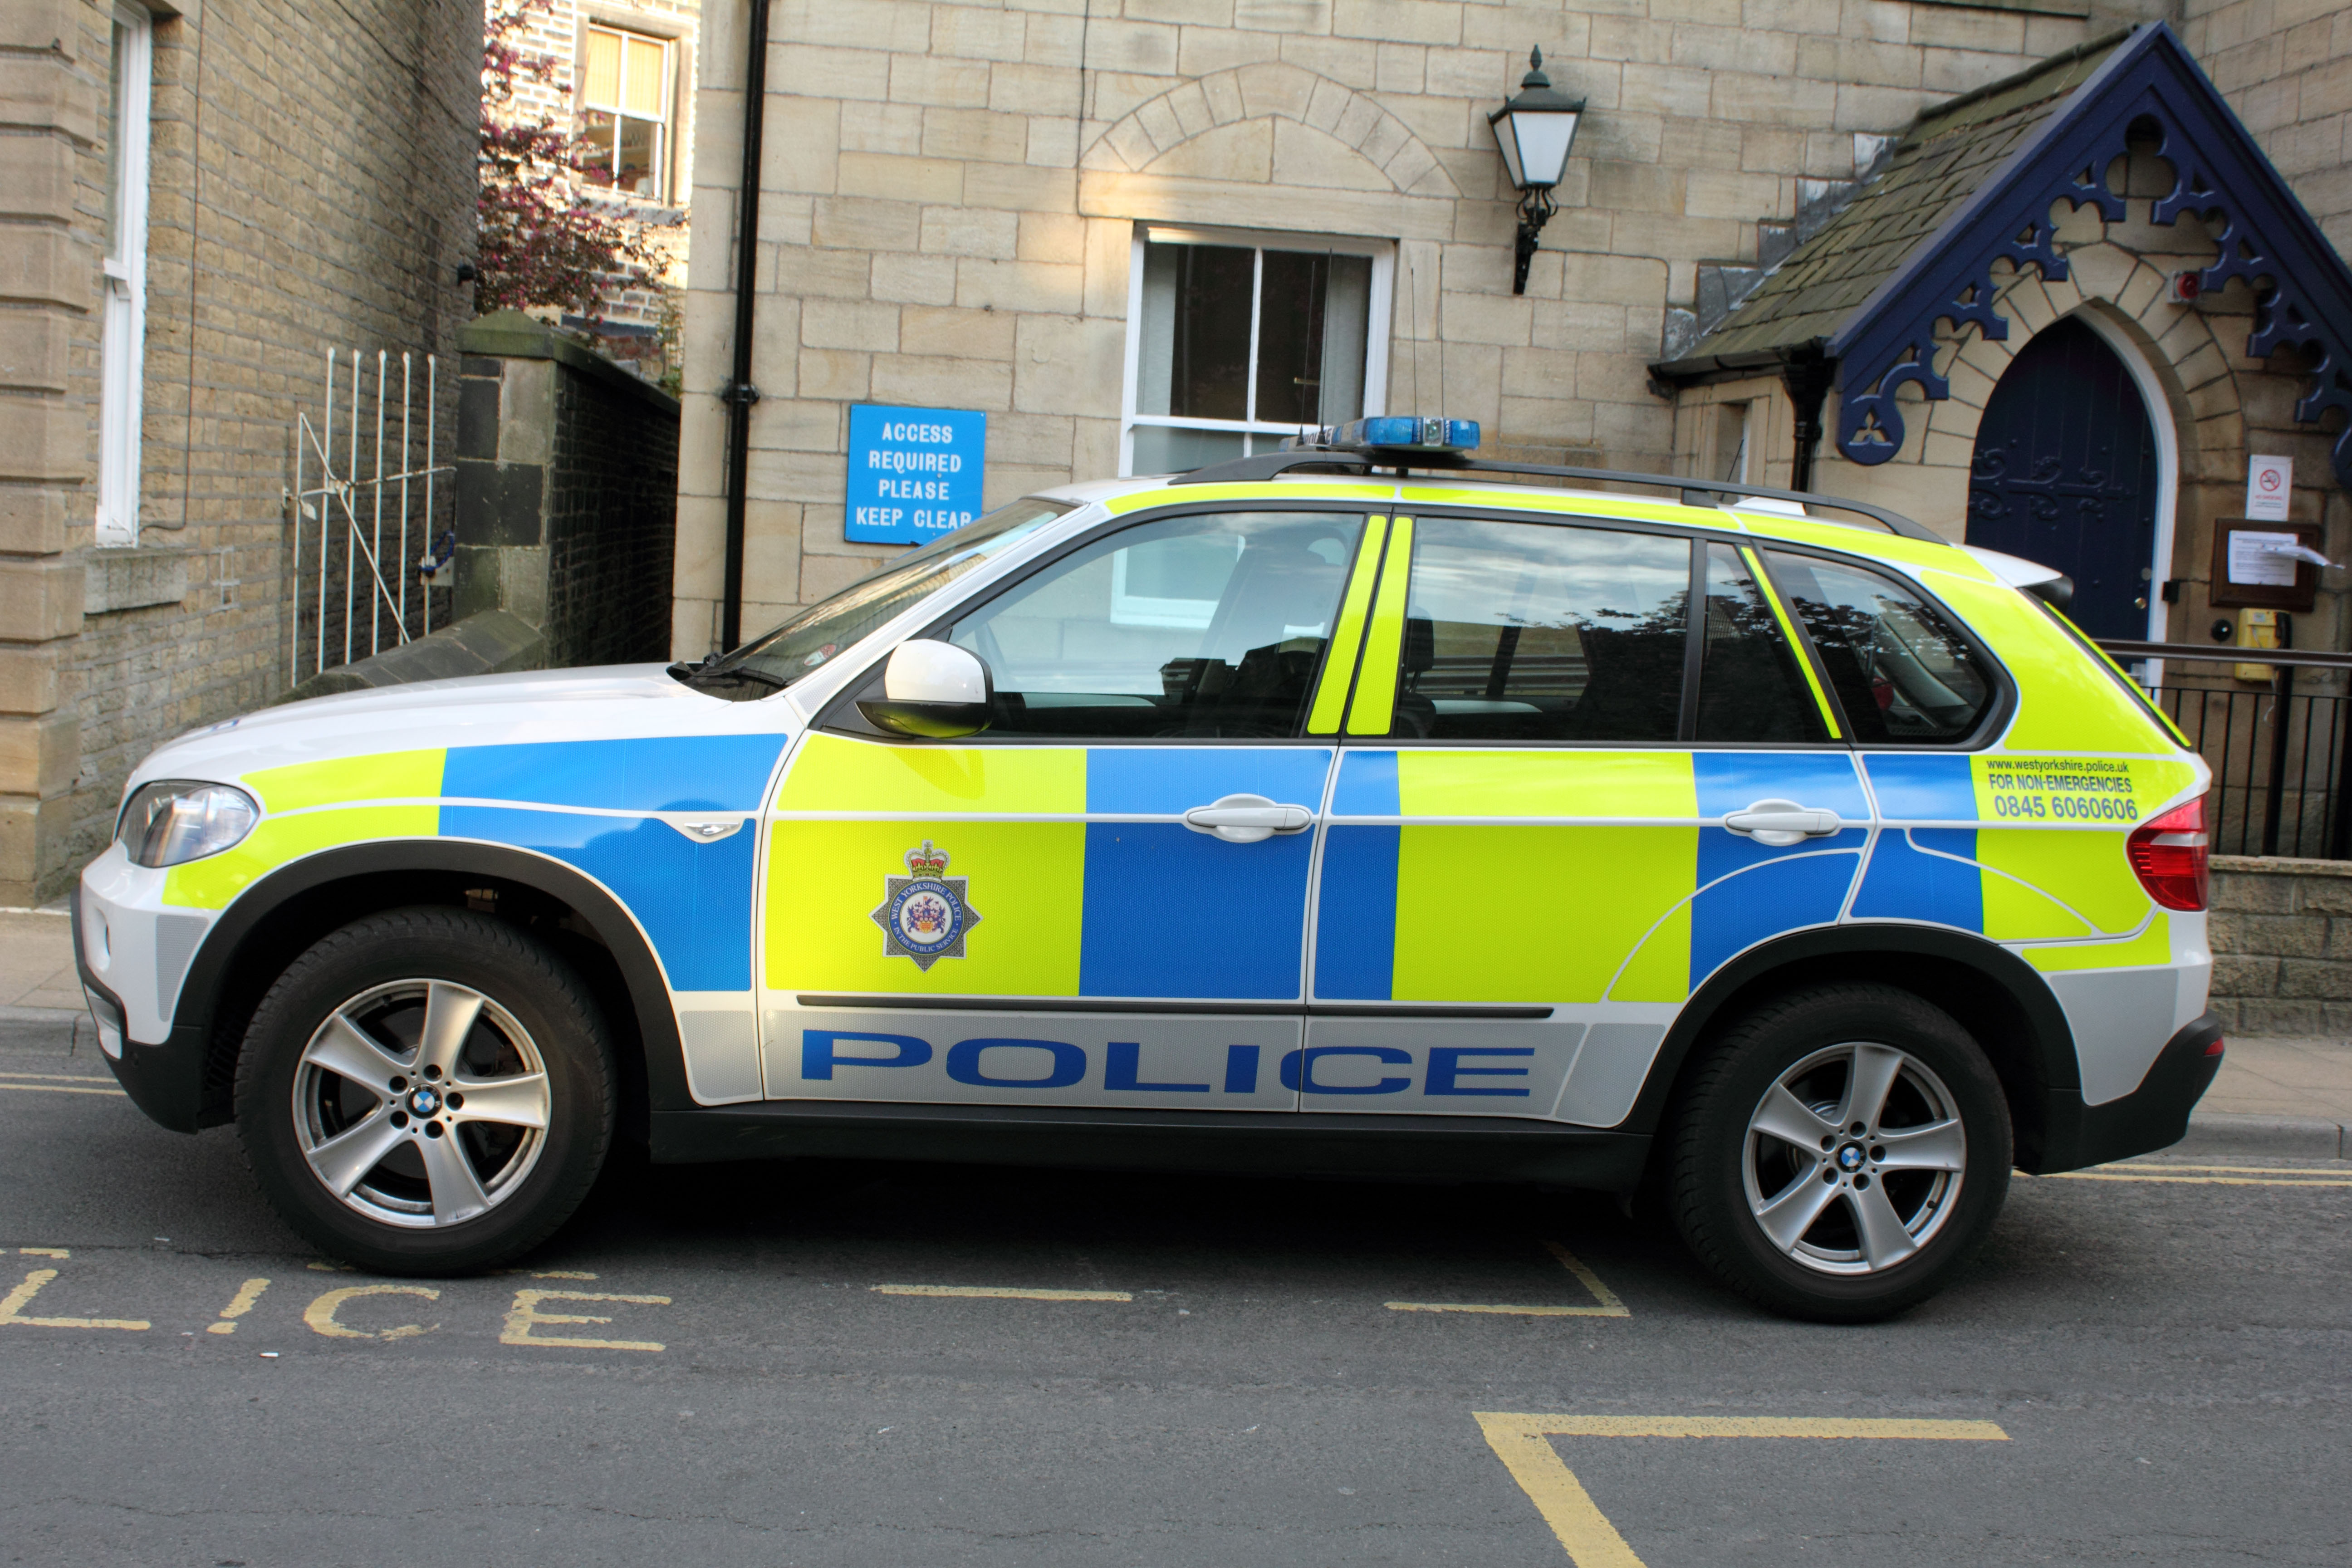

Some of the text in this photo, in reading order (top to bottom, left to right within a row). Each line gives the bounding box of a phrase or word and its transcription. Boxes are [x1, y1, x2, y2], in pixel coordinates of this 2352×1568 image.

[882, 422, 953, 443] ACCESS
[868, 450, 962, 474] REQUIRED
[879, 479, 950, 500] PLEASE
[856, 506, 971, 529] KEEP CLEAR
[1987, 760, 2129, 774] www.westyorkshire.police.uk
[1989, 774, 2132, 793] FOR NON-EMERGENCIES
[1994, 795, 2138, 820] 0845 6060606
[892, 882, 962, 921] WEST YORKSHIRE POLICE
[894, 927, 959, 952] IN THE PUBLIC SERVICE
[801, 1029, 1535, 1097] POLICE
